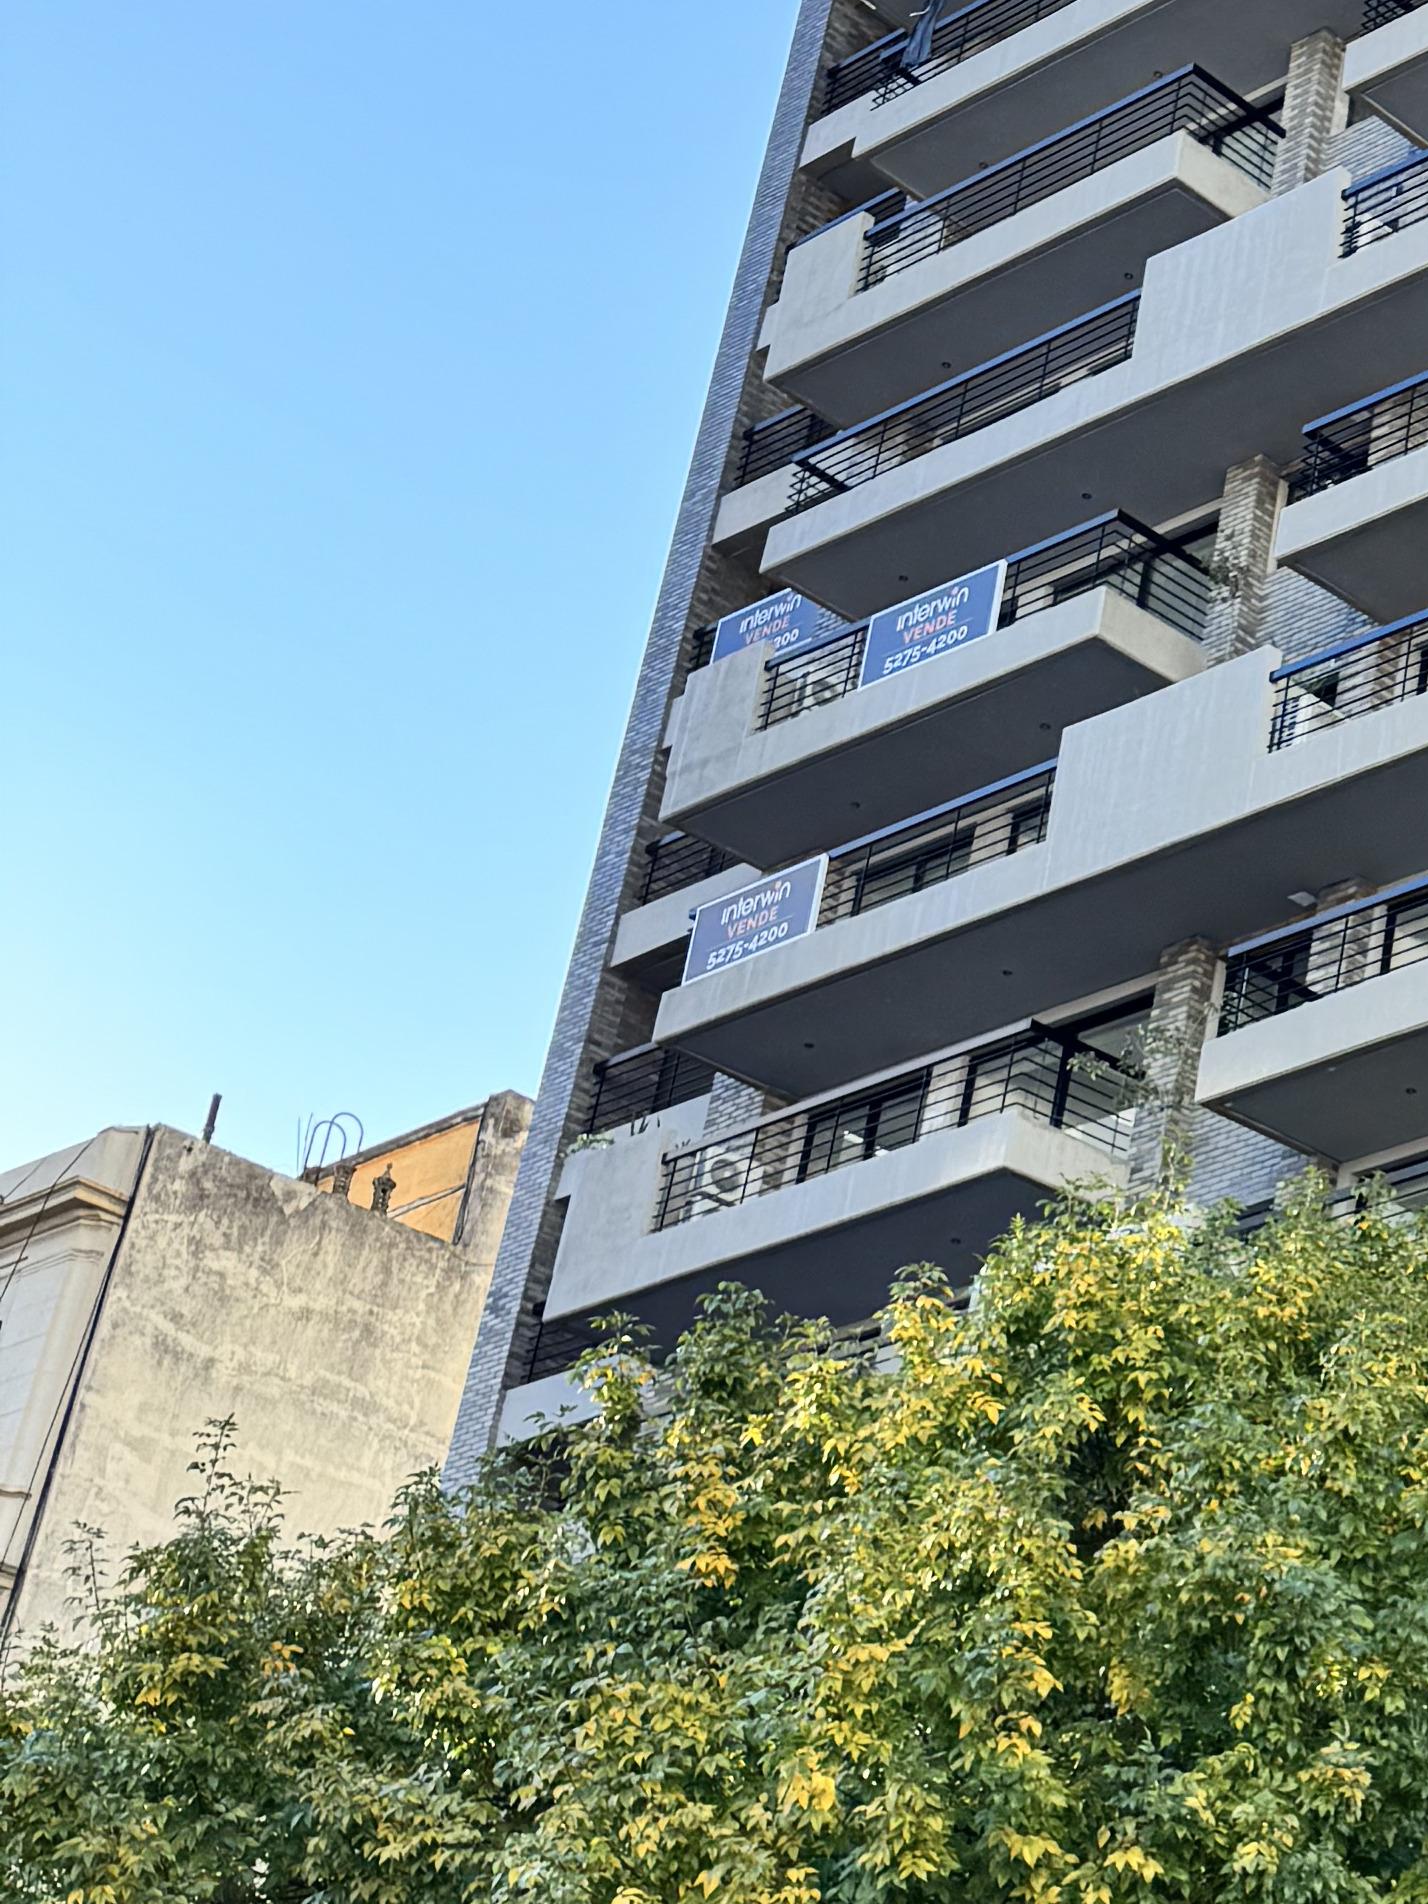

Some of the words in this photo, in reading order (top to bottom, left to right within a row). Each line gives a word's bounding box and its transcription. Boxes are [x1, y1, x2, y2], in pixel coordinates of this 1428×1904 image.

[745, 615, 790, 645] VENDE
[897, 586, 970, 631] interwin
[904, 610, 958, 644] VENDE
[882, 626, 968, 675] 5275-4200
[721, 880, 791, 926] interwin
[727, 905, 779, 939] VENDE
[706, 922, 789, 970] 5275-4200
